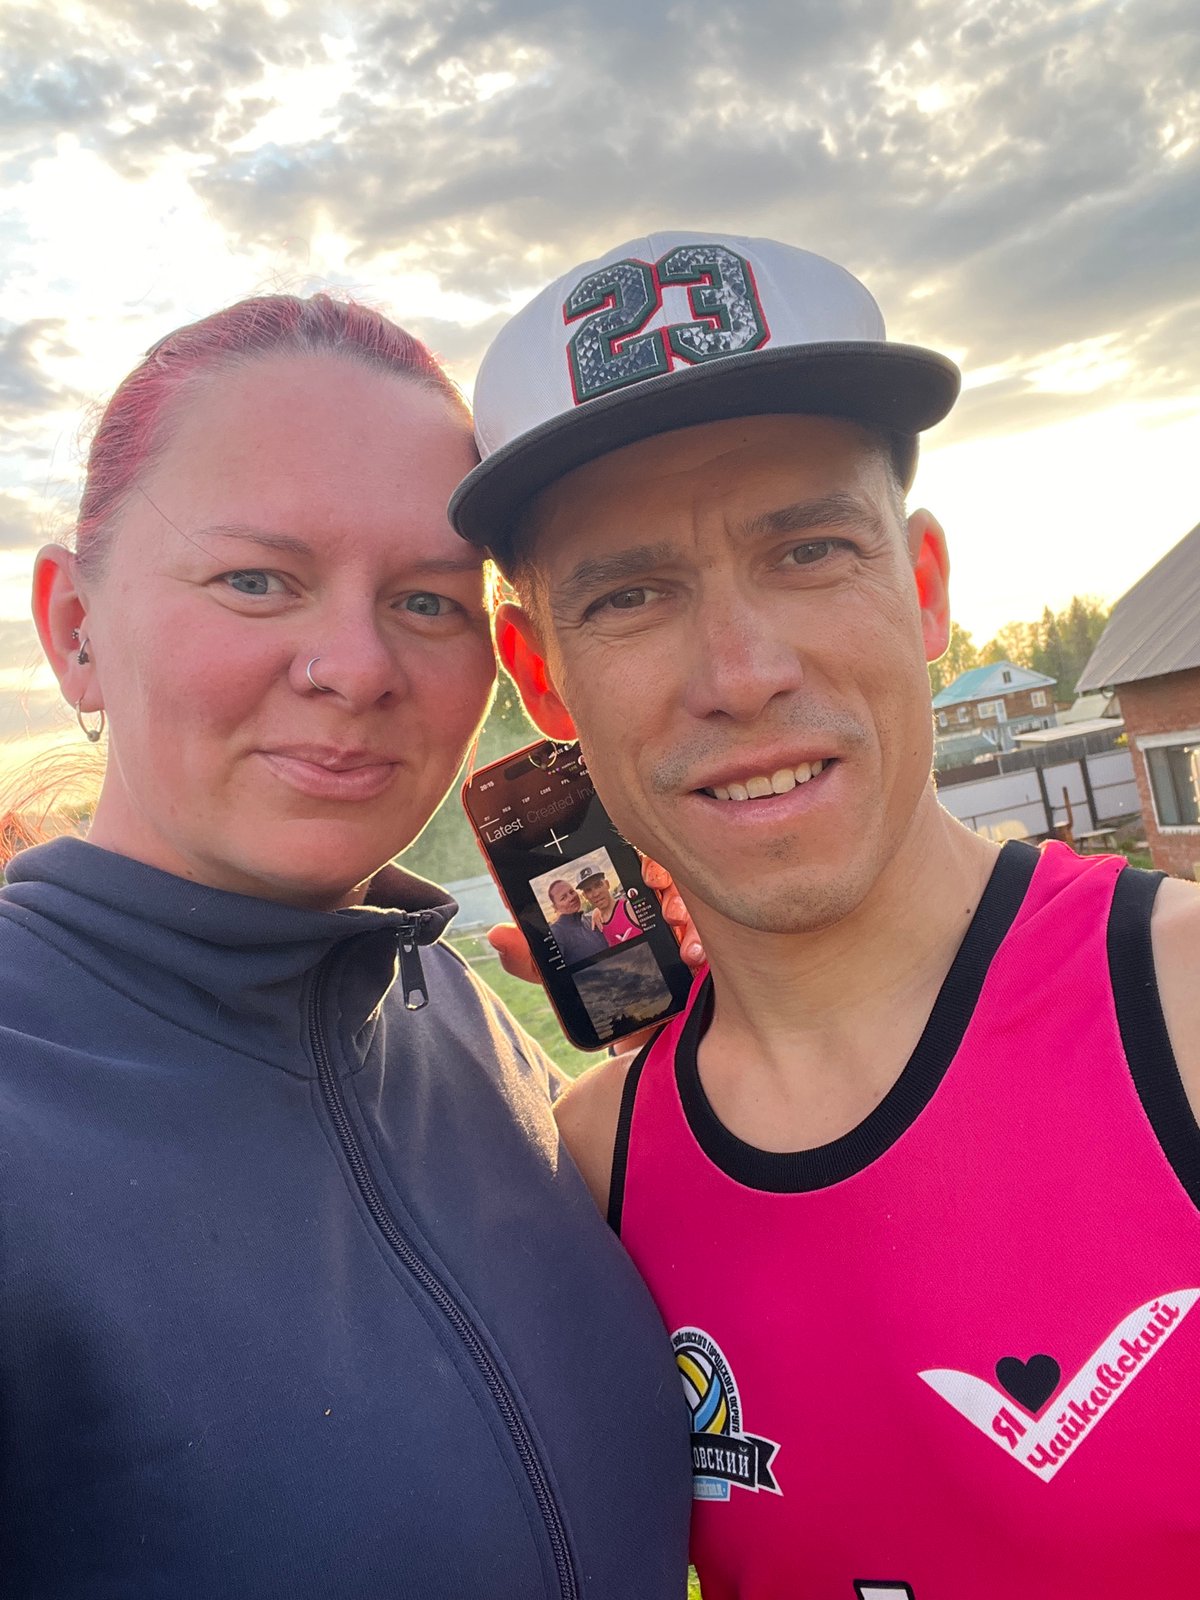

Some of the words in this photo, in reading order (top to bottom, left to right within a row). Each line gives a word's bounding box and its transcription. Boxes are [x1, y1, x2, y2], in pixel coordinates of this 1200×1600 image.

[563, 244, 771, 406] 23
[486, 818, 524, 843] Latest
[526, 794, 574, 824] Created
[577, 785, 595, 800] Inv
[729, 1395, 741, 1434] ОКРУГА
[991, 1407, 1027, 1449] Я
[693, 1446, 750, 1477] ОВСКИЙ
